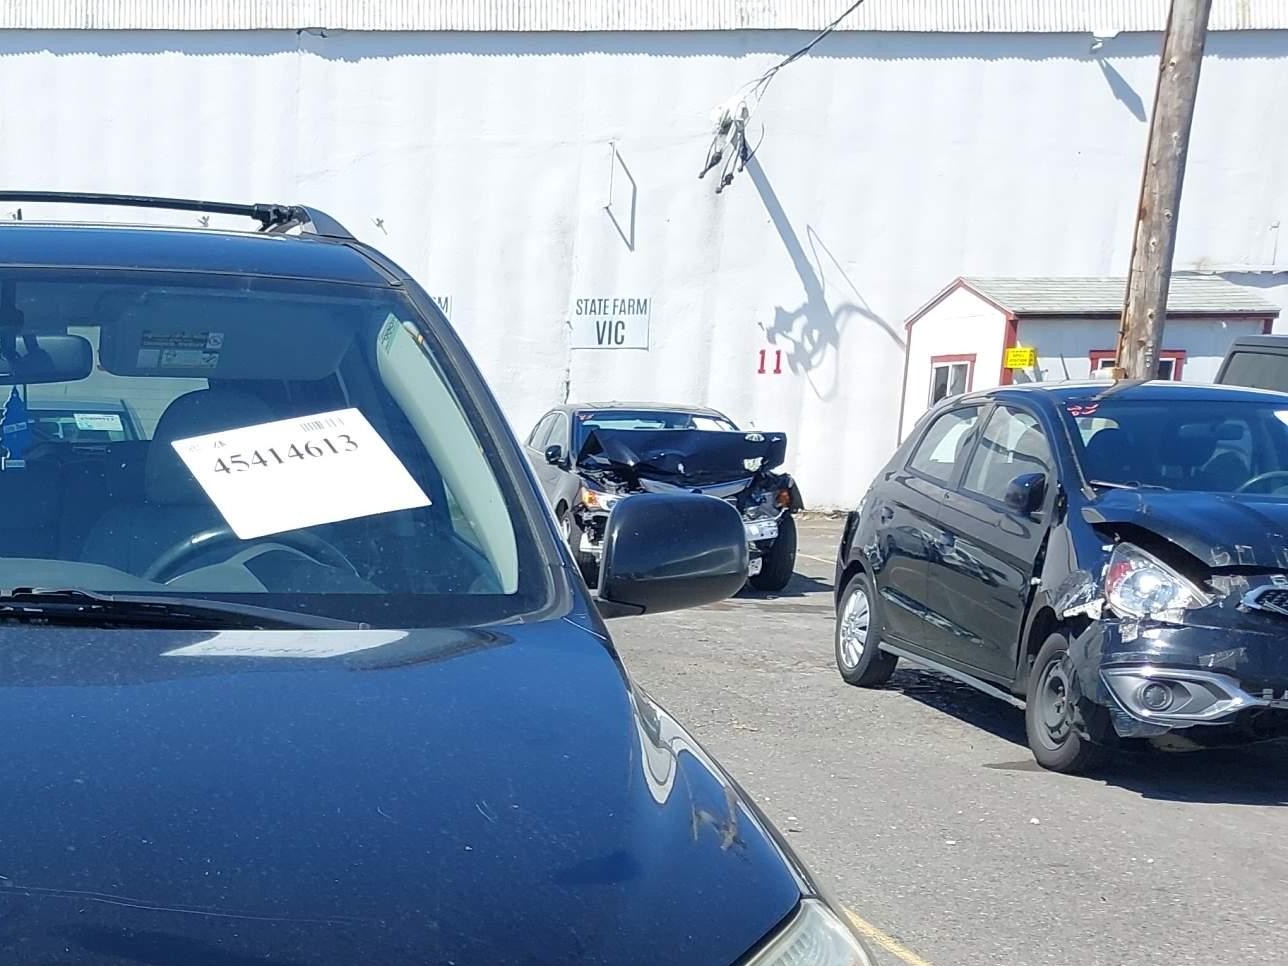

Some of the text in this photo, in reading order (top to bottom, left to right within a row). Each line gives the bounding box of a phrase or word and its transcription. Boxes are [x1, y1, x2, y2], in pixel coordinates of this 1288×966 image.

[575, 298, 648, 316] STATE FARM
[596, 320, 626, 346] VIC
[757, 349, 782, 375] 11
[214, 434, 359, 475] 45414613
